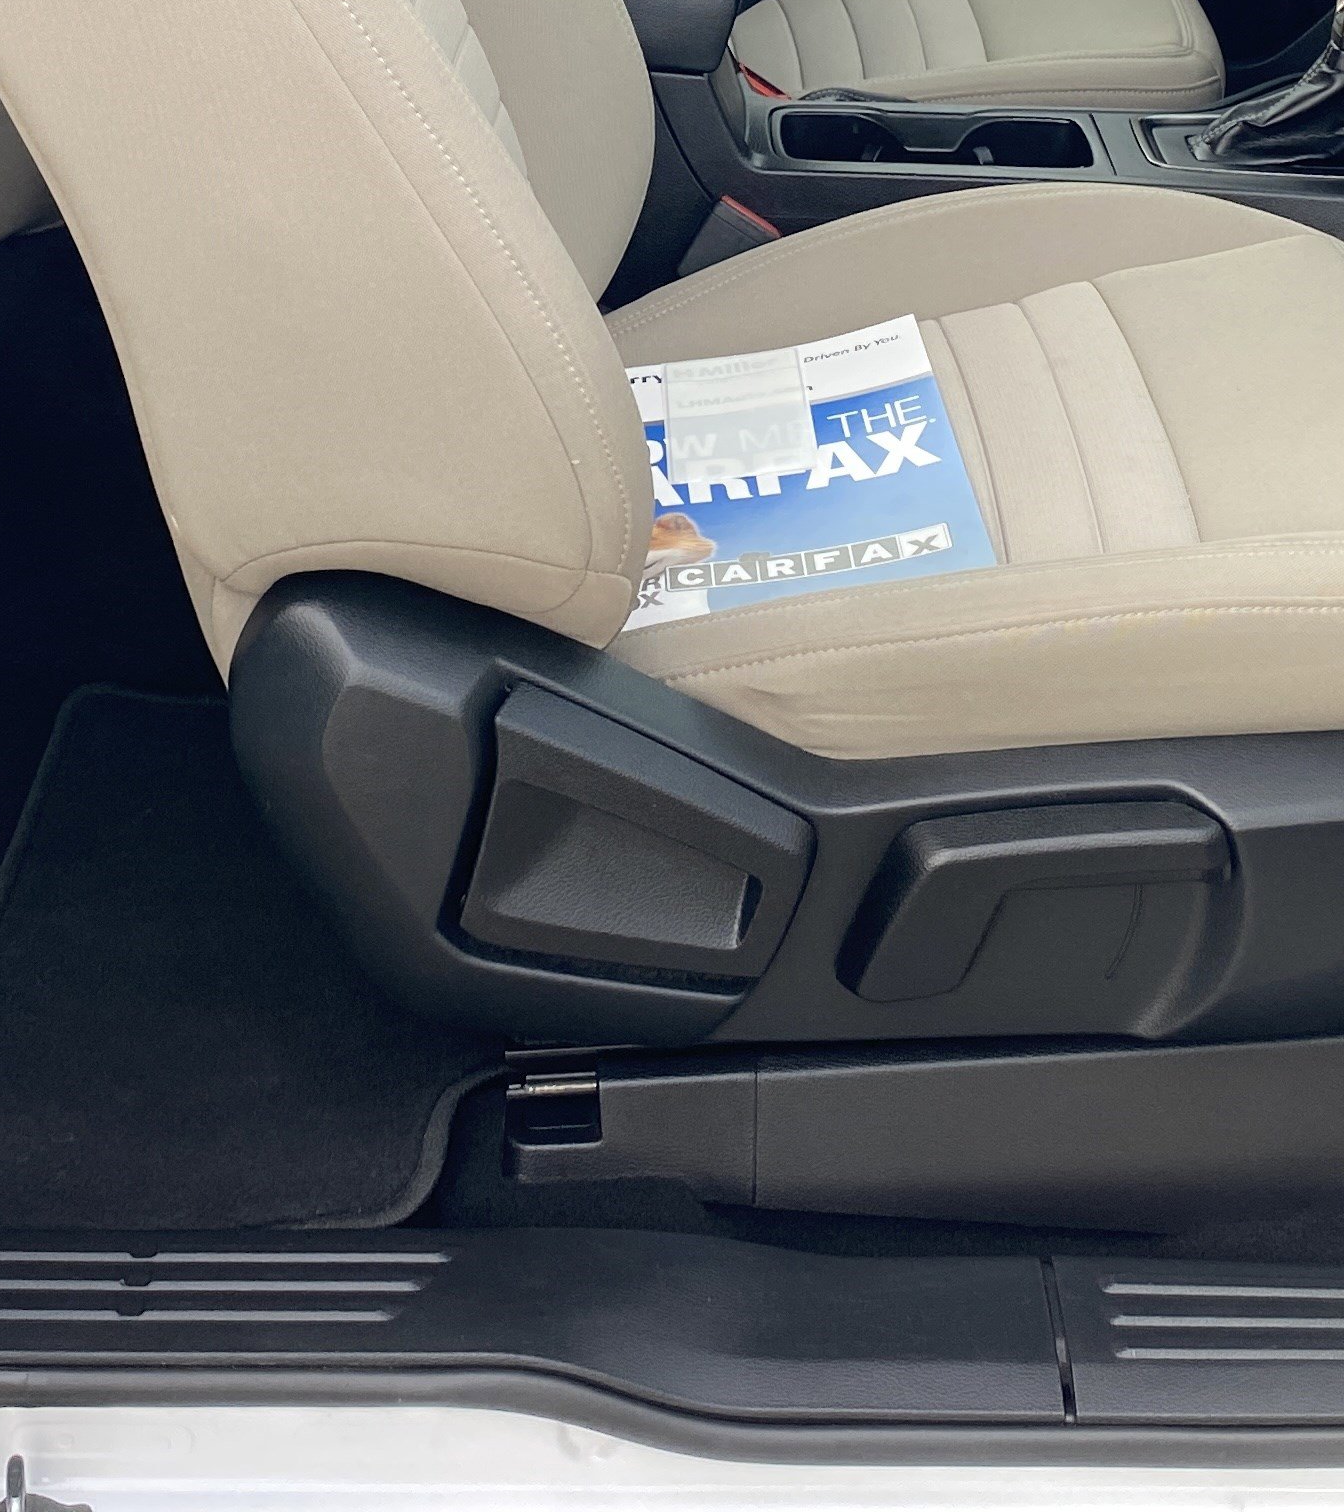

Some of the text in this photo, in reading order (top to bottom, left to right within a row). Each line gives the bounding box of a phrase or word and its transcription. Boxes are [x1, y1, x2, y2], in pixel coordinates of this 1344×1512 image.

[803, 348, 850, 364] Driven
[854, 342, 871, 352] By
[652, 420, 943, 507] ARFAX
[677, 533, 942, 586] CARFAX
